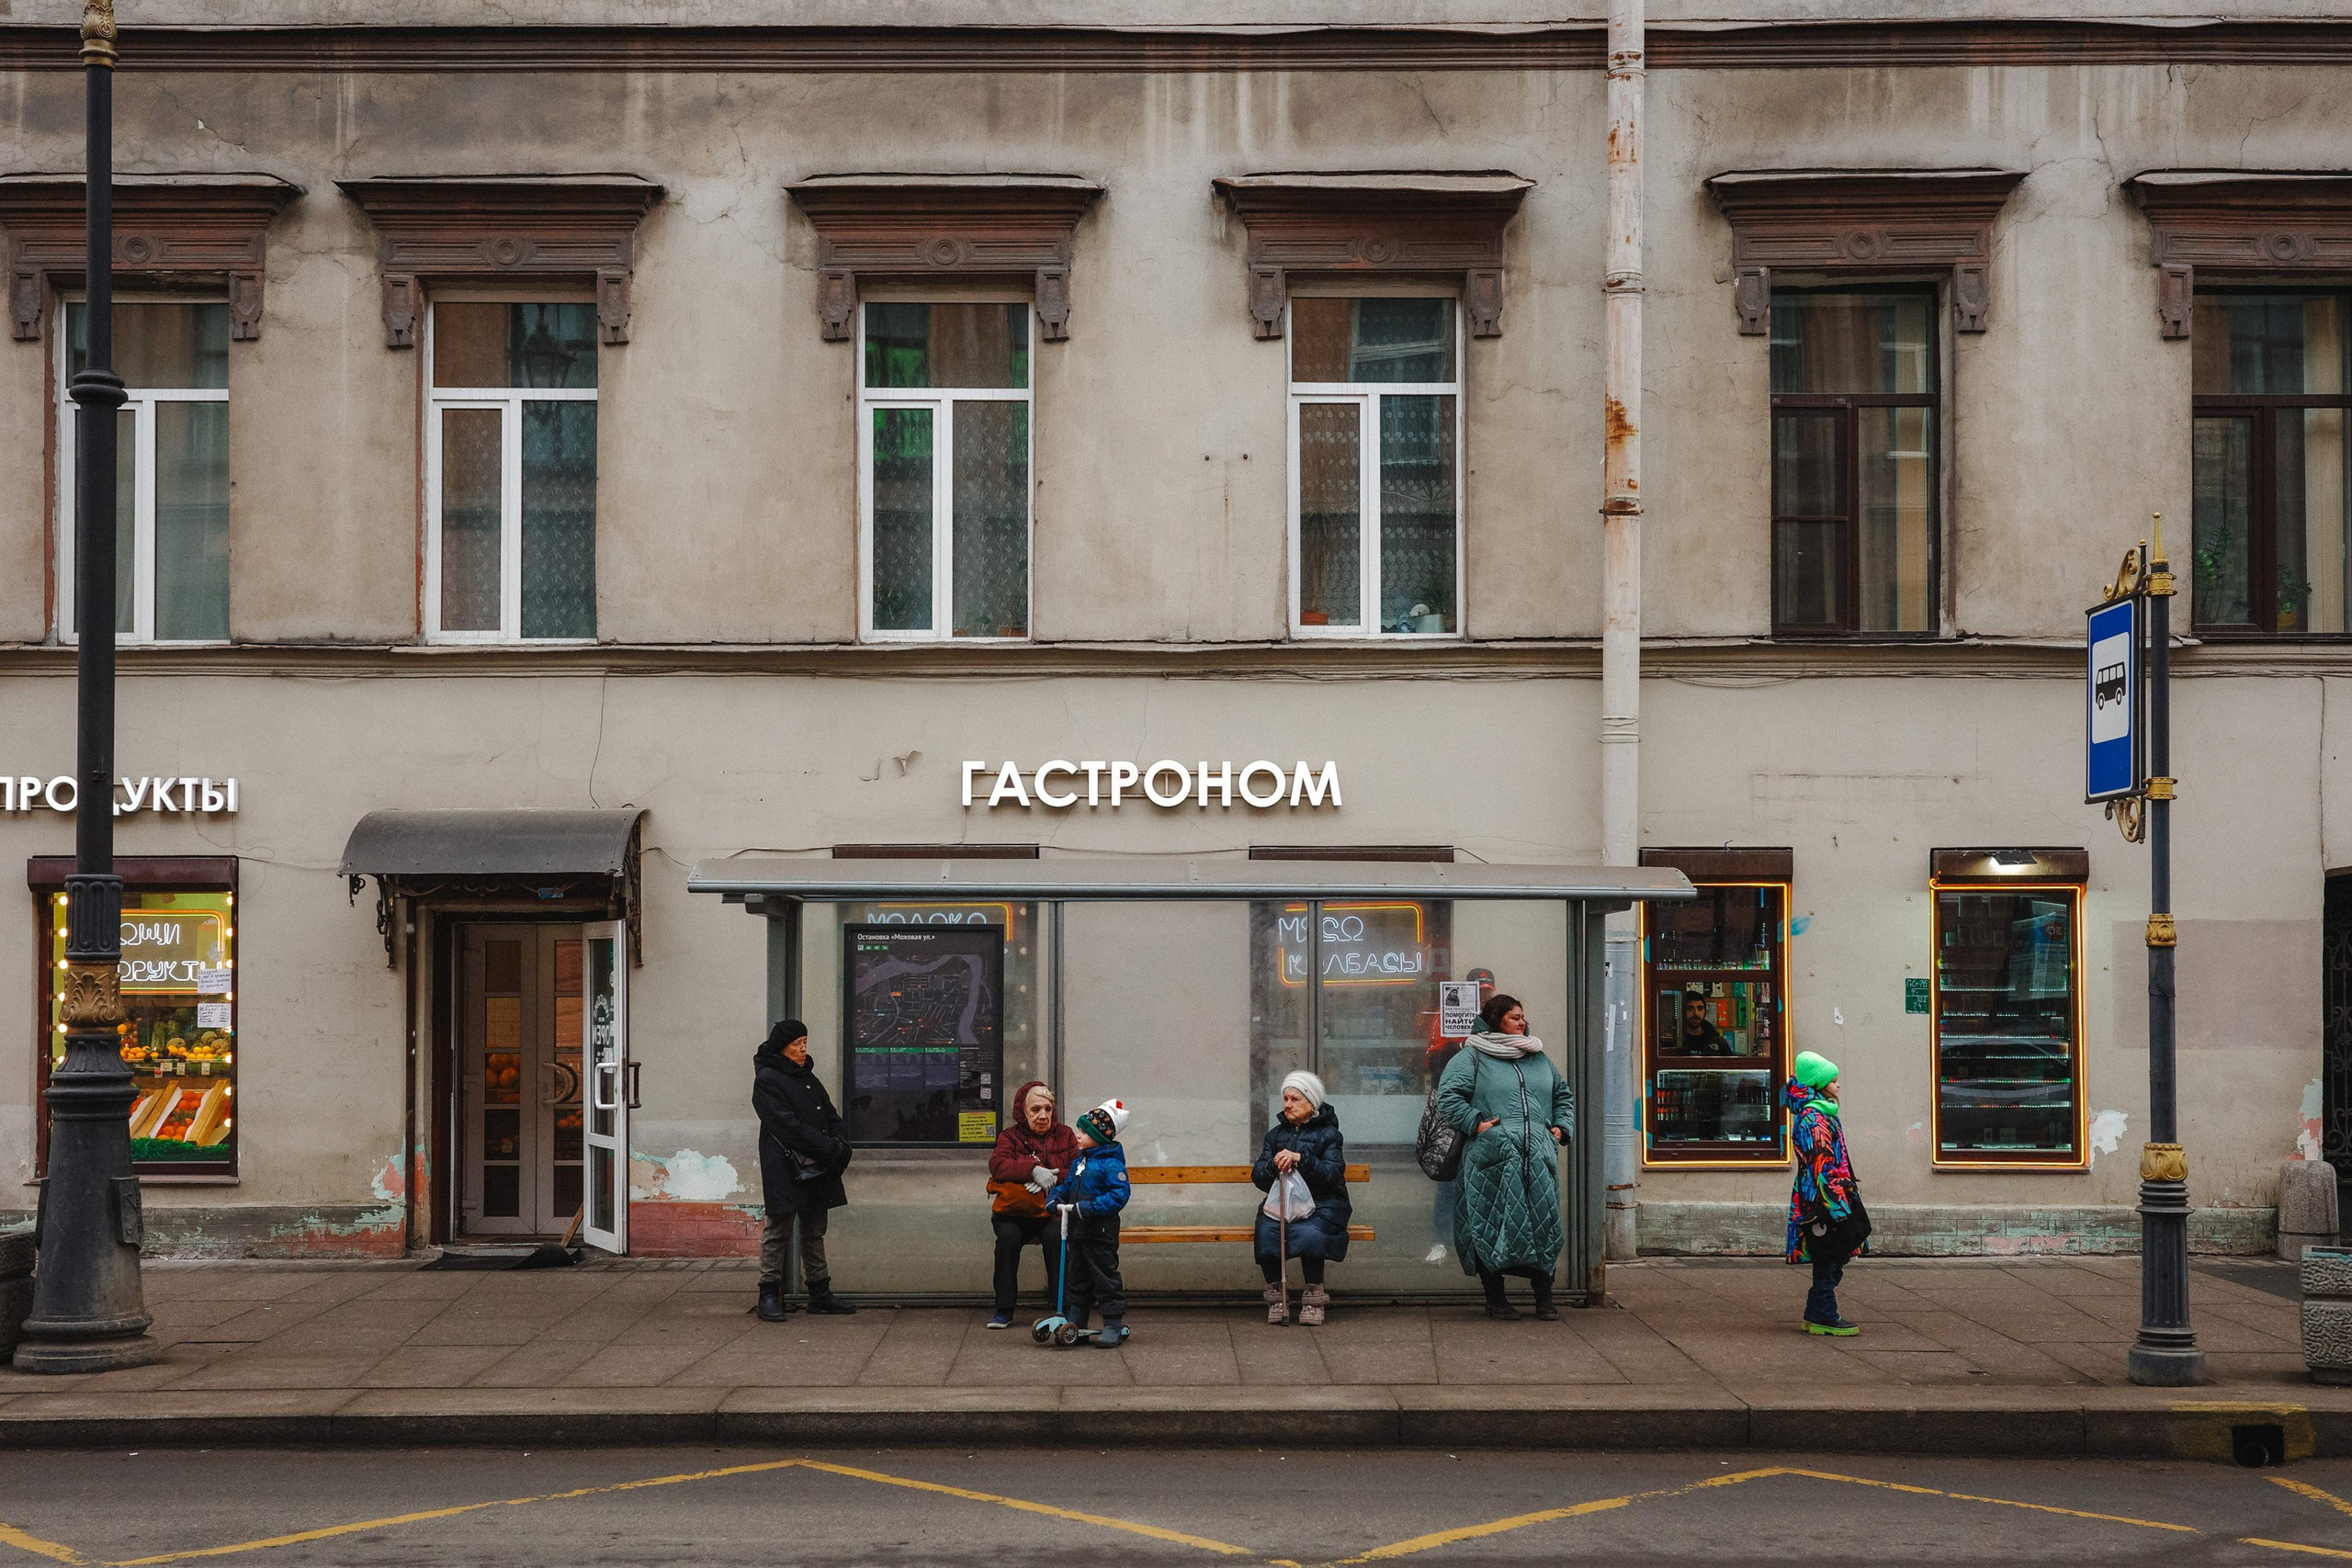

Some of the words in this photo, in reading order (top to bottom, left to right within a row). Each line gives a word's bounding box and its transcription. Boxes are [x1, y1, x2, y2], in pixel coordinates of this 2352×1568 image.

[0, 775, 239, 816] ПРОУКТЫ
[962, 759, 1342, 807] ГАСТРОНОМ
[120, 922, 180, 945] ОЩИ
[1289, 952, 1421, 976] КЛБАСЫ
